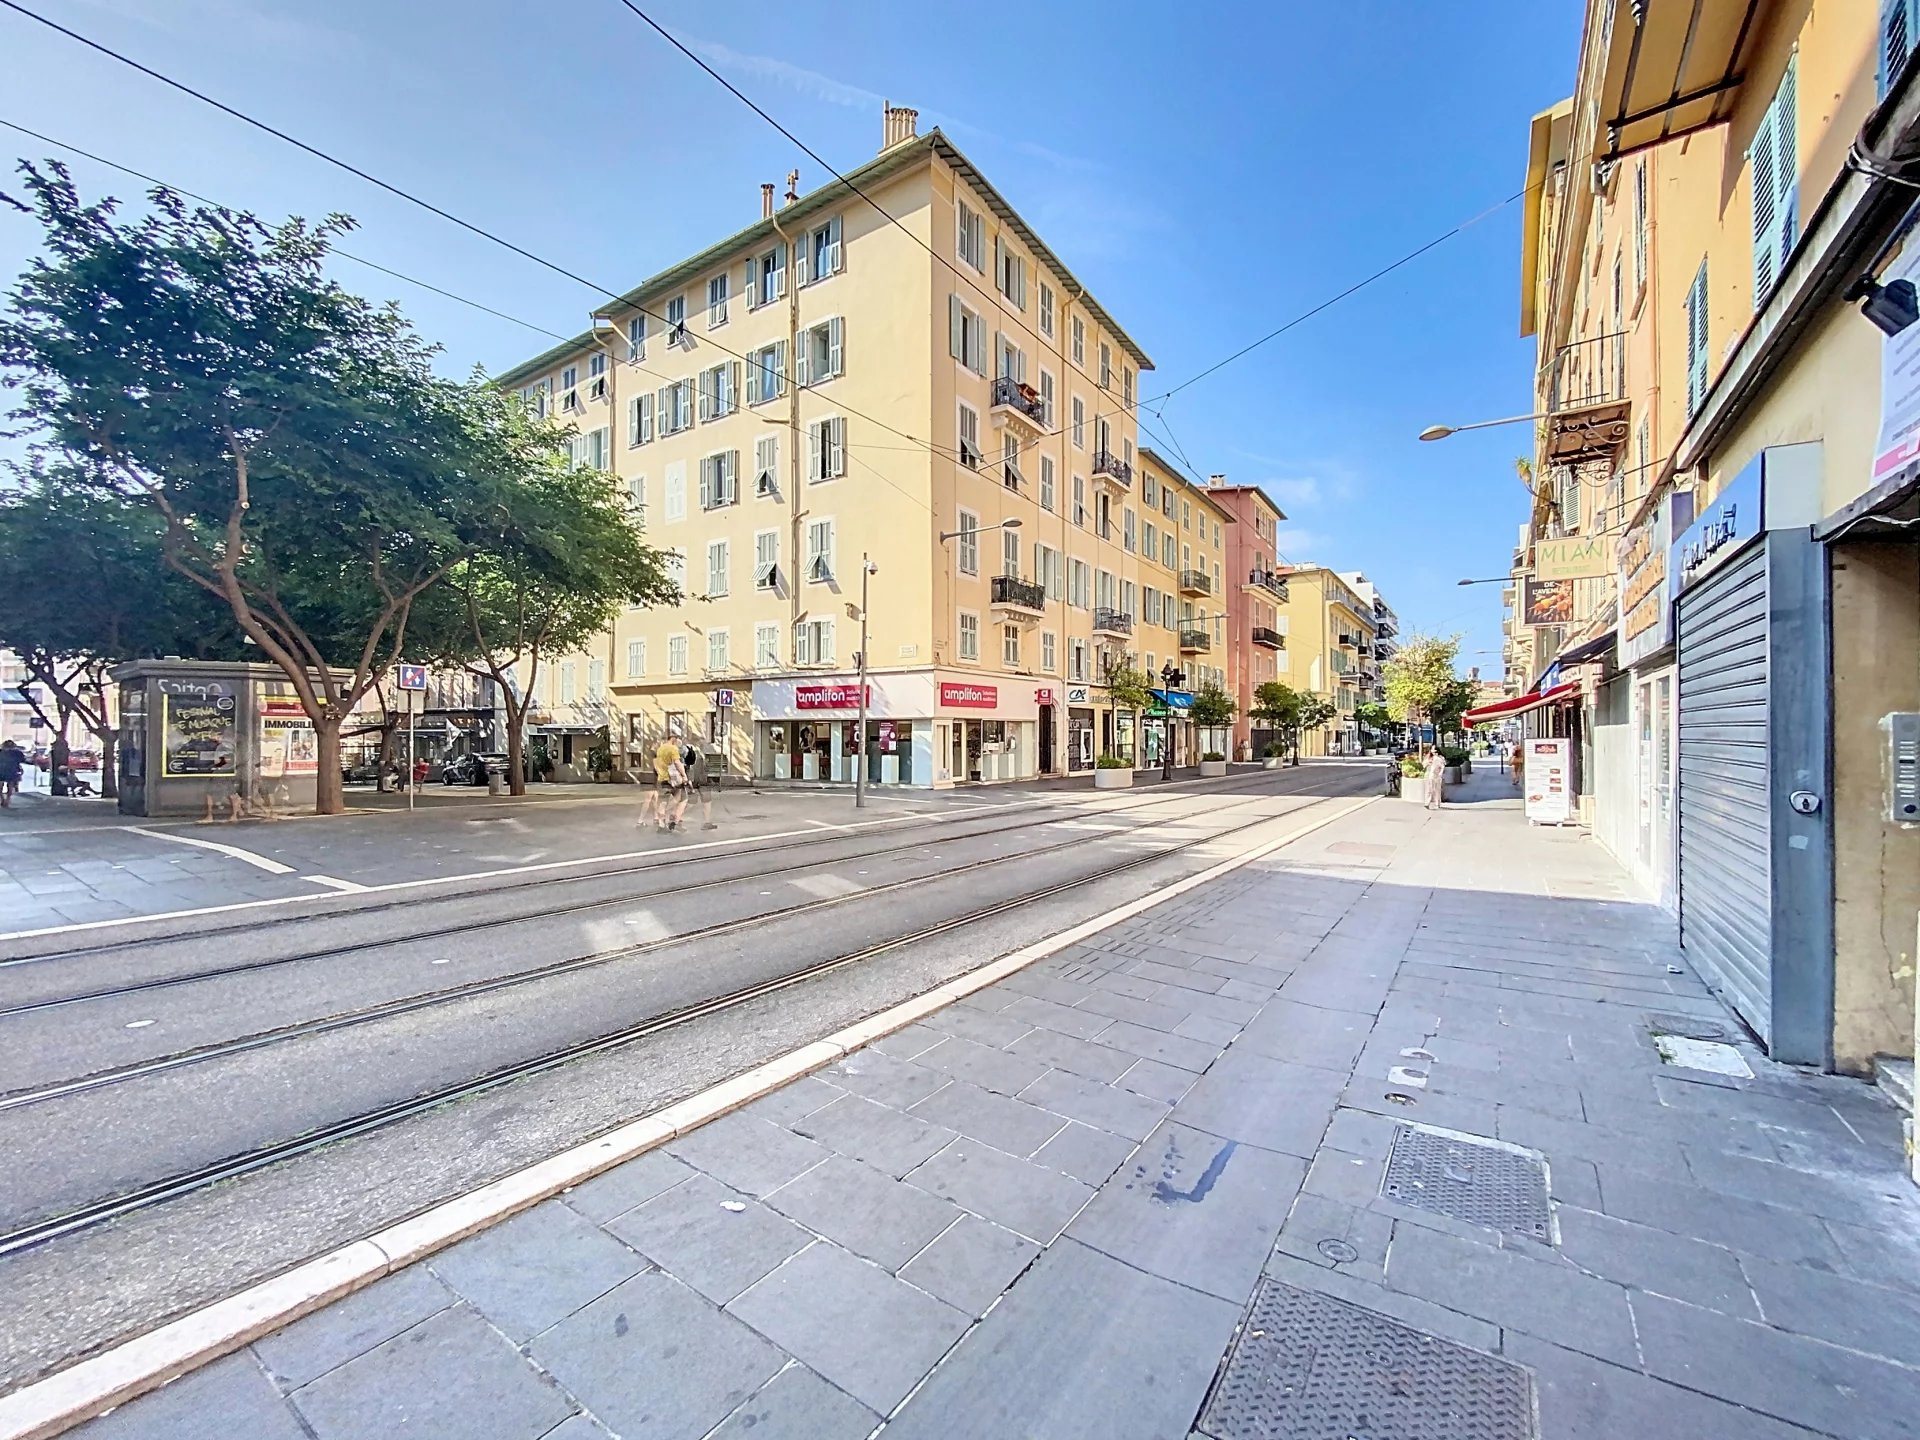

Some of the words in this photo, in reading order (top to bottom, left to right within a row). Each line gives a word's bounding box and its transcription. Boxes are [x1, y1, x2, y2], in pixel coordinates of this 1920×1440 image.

[1541, 540, 1604, 563] MIAN
[798, 689, 845, 705] amplifon
[944, 688, 982, 703] amplifon
[188, 717, 233, 729] MUSIQUE
